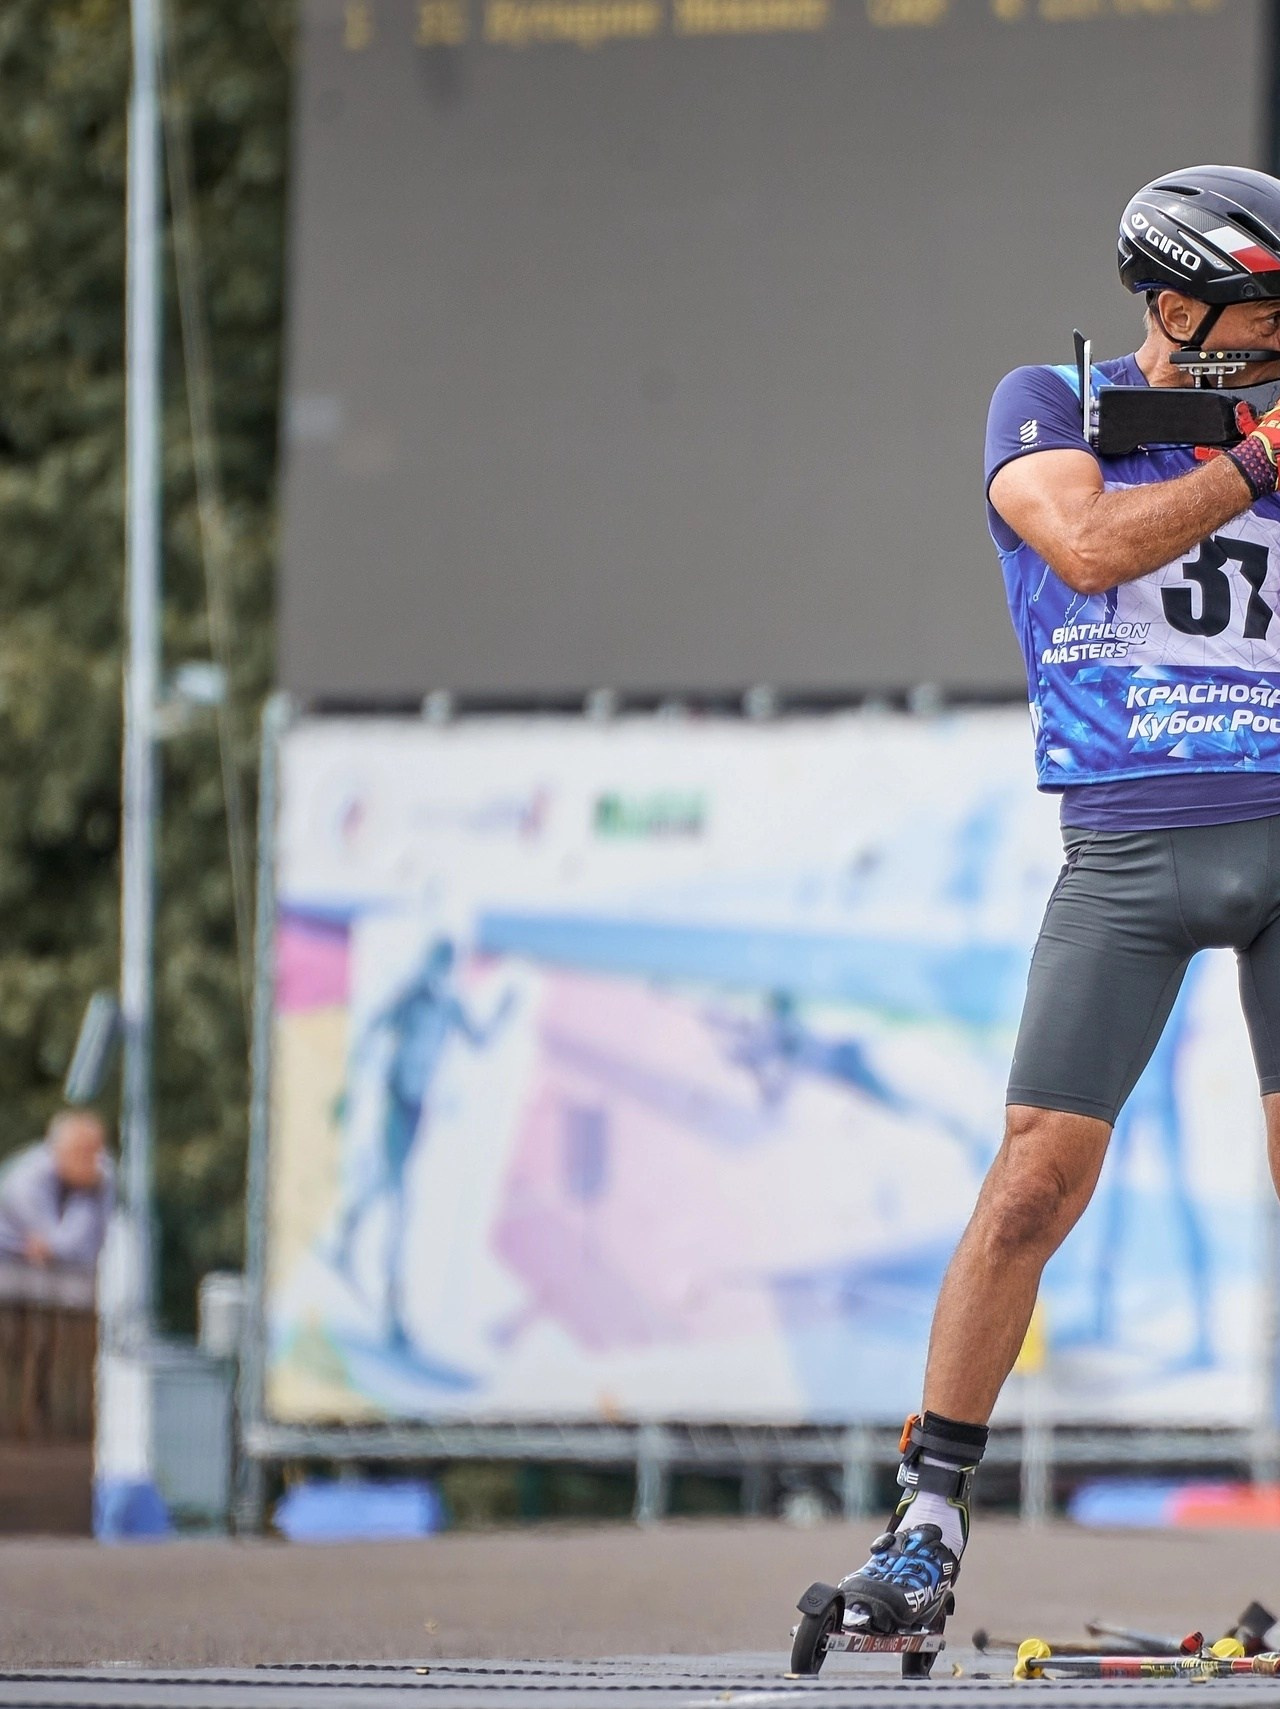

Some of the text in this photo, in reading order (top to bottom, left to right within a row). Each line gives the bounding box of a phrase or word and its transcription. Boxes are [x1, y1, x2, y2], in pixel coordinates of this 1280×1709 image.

[1145, 226, 1201, 271] GIRO
[1160, 534, 1275, 641] 37
[1051, 622, 1151, 645] BIATHLON
[1041, 642, 1129, 664] MASTERS
[1127, 711, 1226, 742] Кубок
[903, 1580, 951, 1613] SPINE
